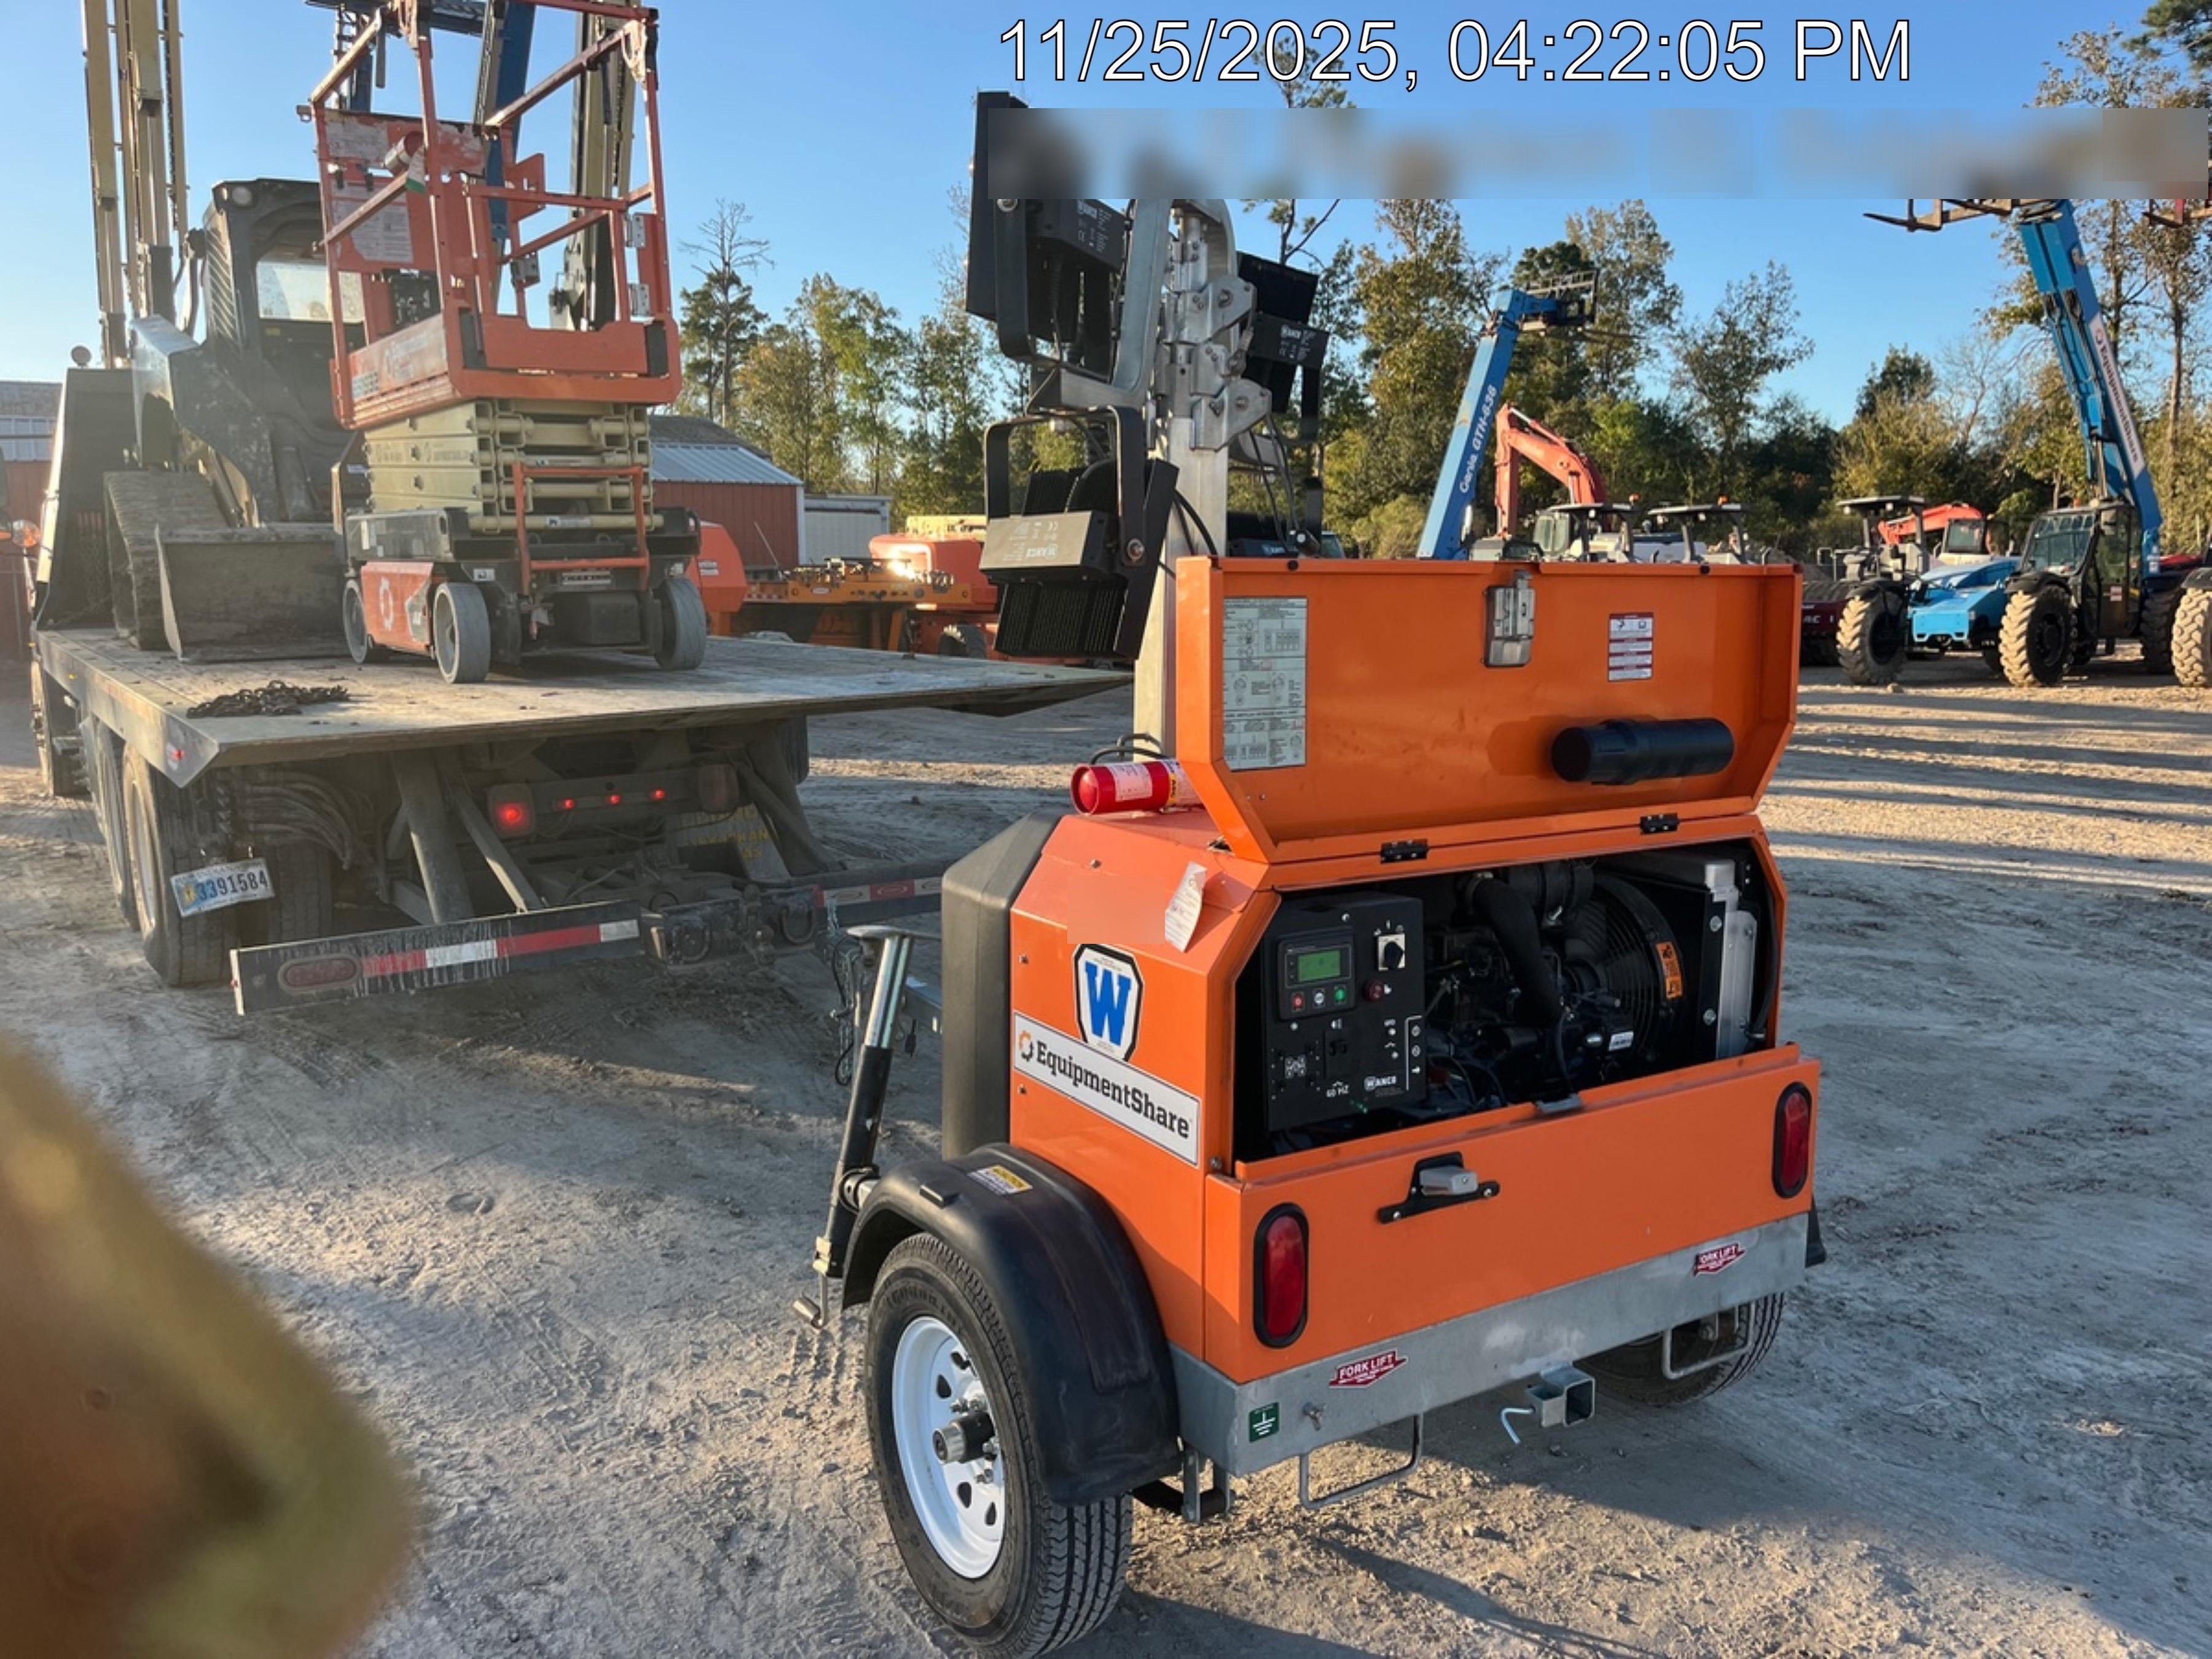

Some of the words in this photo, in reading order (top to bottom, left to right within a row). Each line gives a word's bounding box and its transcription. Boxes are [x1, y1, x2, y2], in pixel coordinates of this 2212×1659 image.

[195, 869, 269, 901] 3391584
[1084, 960, 1132, 1048] W
[1035, 1040, 1190, 1139] EquipmentShare
[1339, 1361, 1368, 1380] FORK
[1370, 1354, 1393, 1370] LIFT
